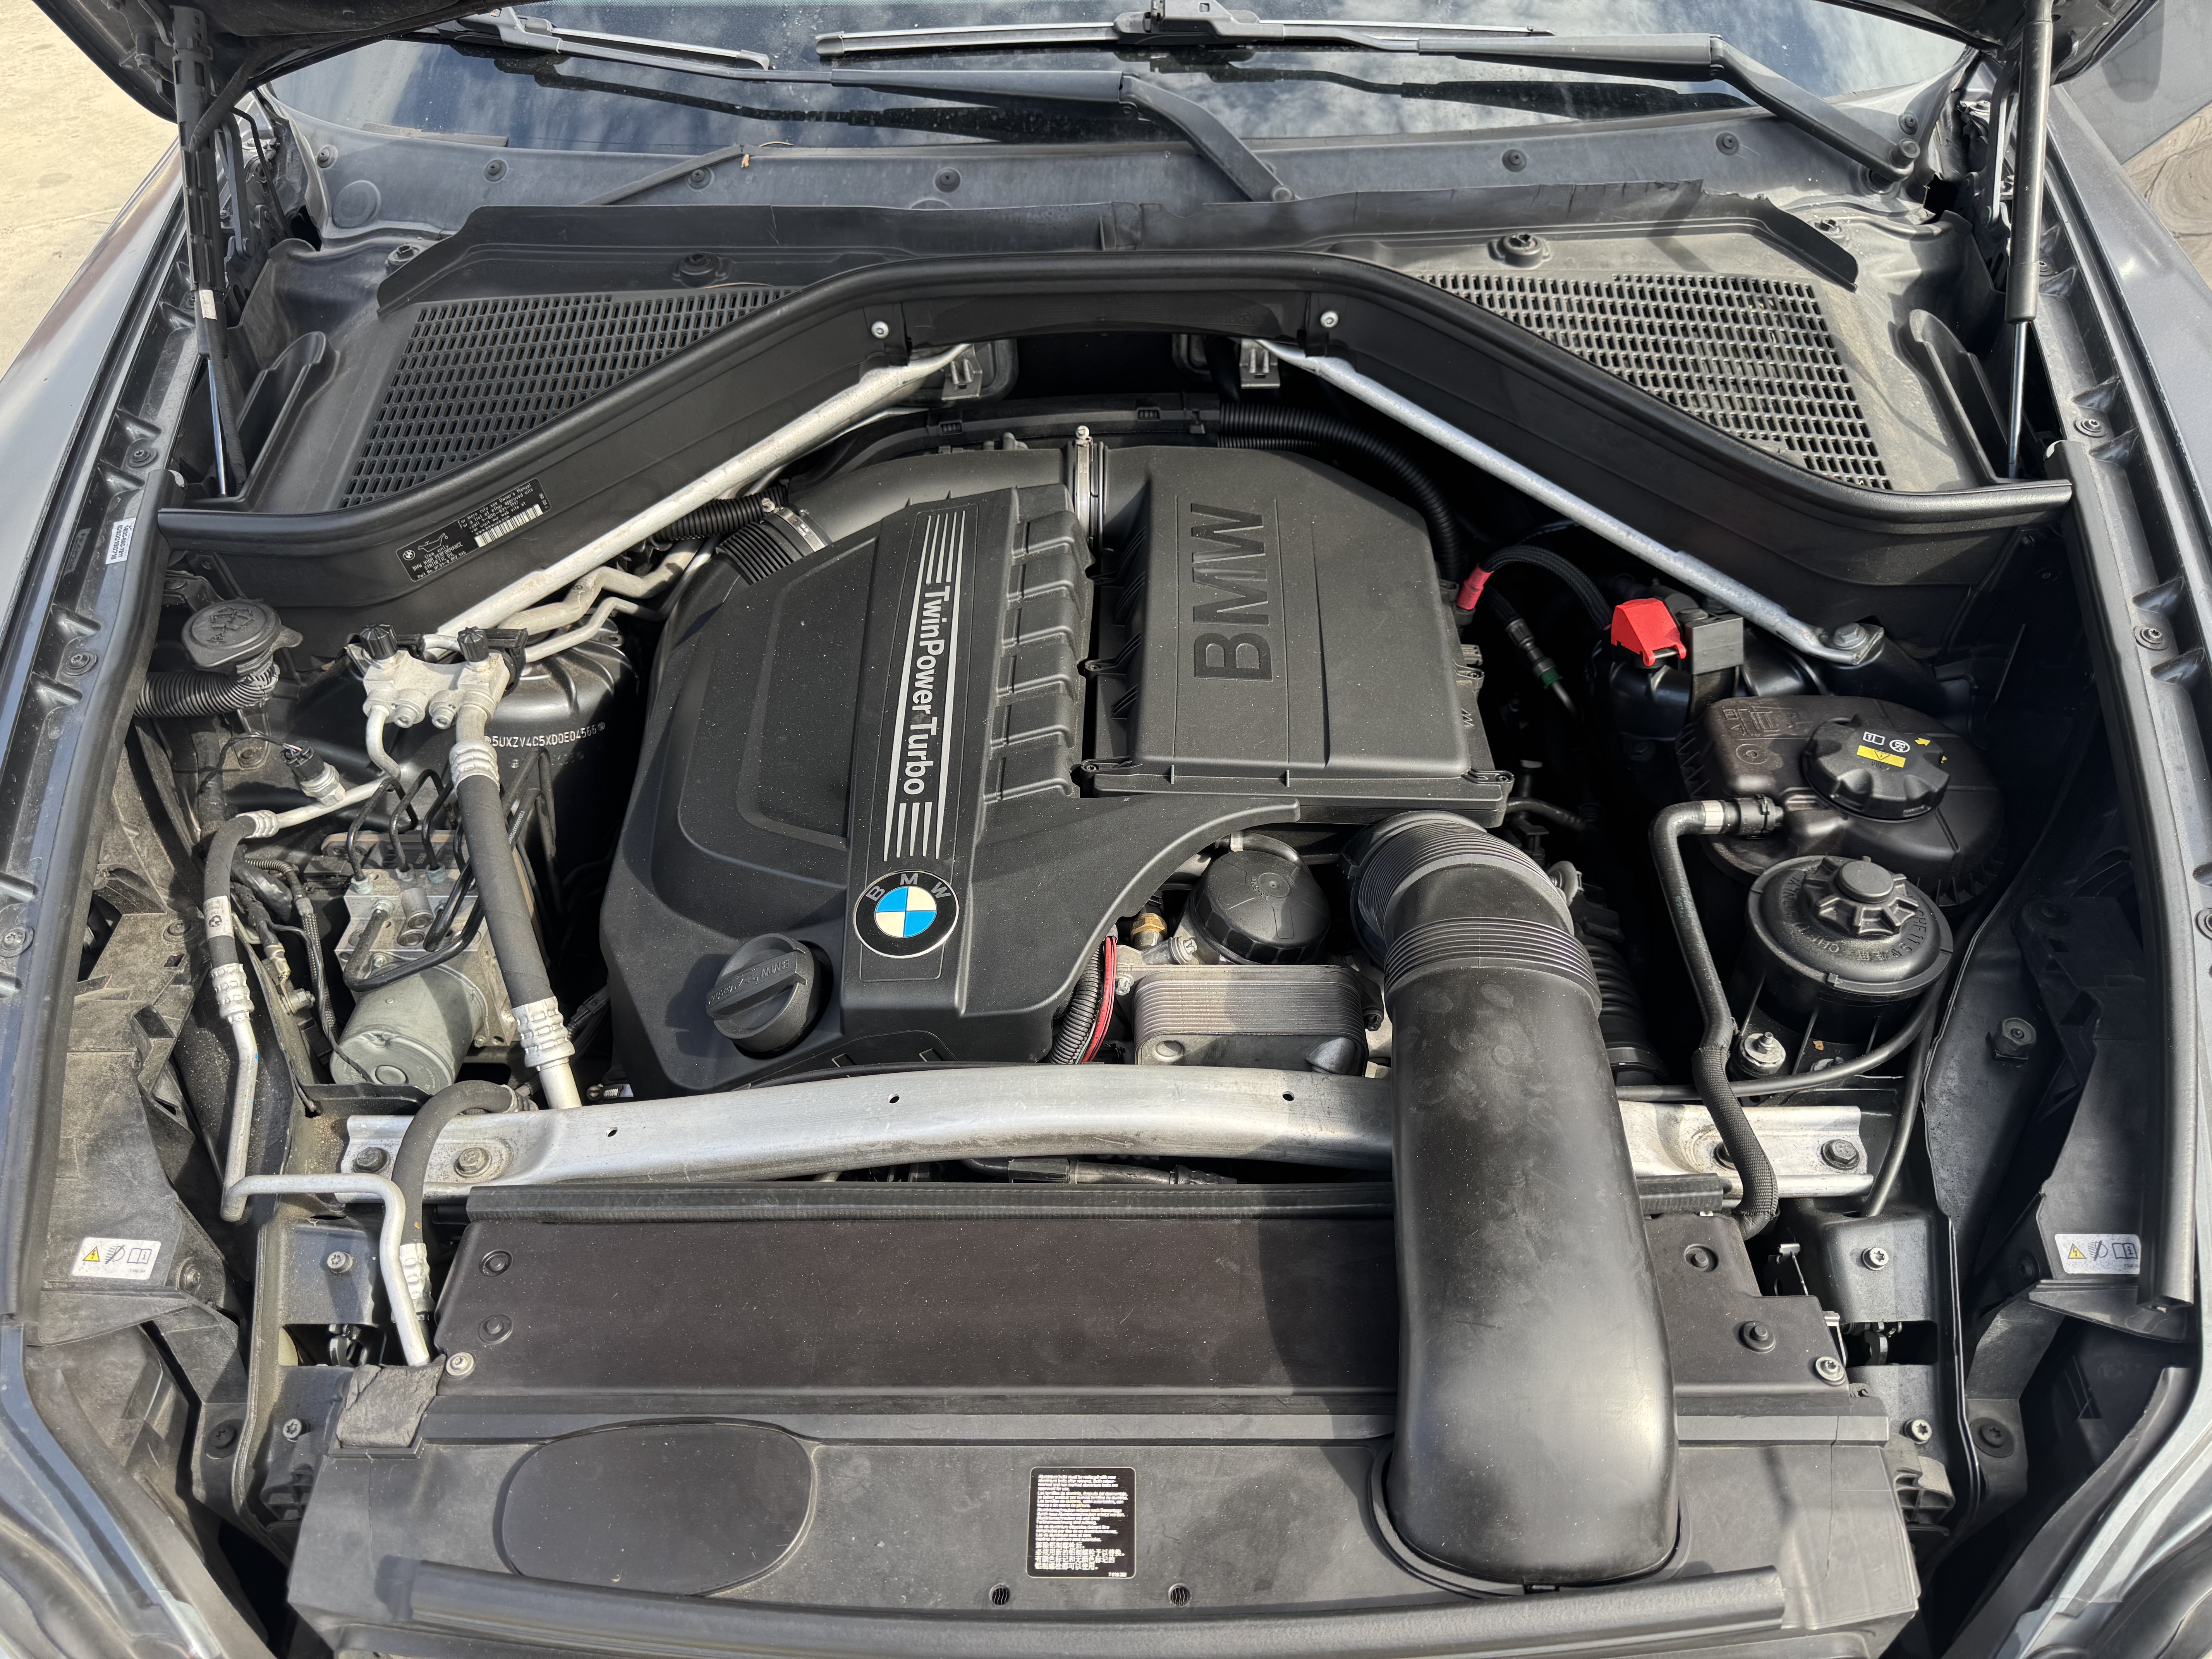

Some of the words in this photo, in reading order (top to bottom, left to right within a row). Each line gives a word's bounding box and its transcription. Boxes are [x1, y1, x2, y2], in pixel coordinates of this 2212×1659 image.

[516, 483, 531, 493] Manual
[491, 503, 503, 512] other
[504, 493, 524, 506] approved
[479, 520, 490, 528] visit
[412, 562, 422, 571] BMW
[423, 556, 434, 565] HIGH
[434, 541, 463, 559] PERFORMANCE
[424, 551, 434, 559] Use
[436, 543, 450, 553] only
[424, 556, 446, 570] SYNTHETIC
[1190, 503, 1273, 682] BMW
[912, 586, 950, 715] TwinPower
[903, 717, 938, 795] Turbo
[866, 873, 952, 902] BMW
[761, 959, 790, 978] BMW
